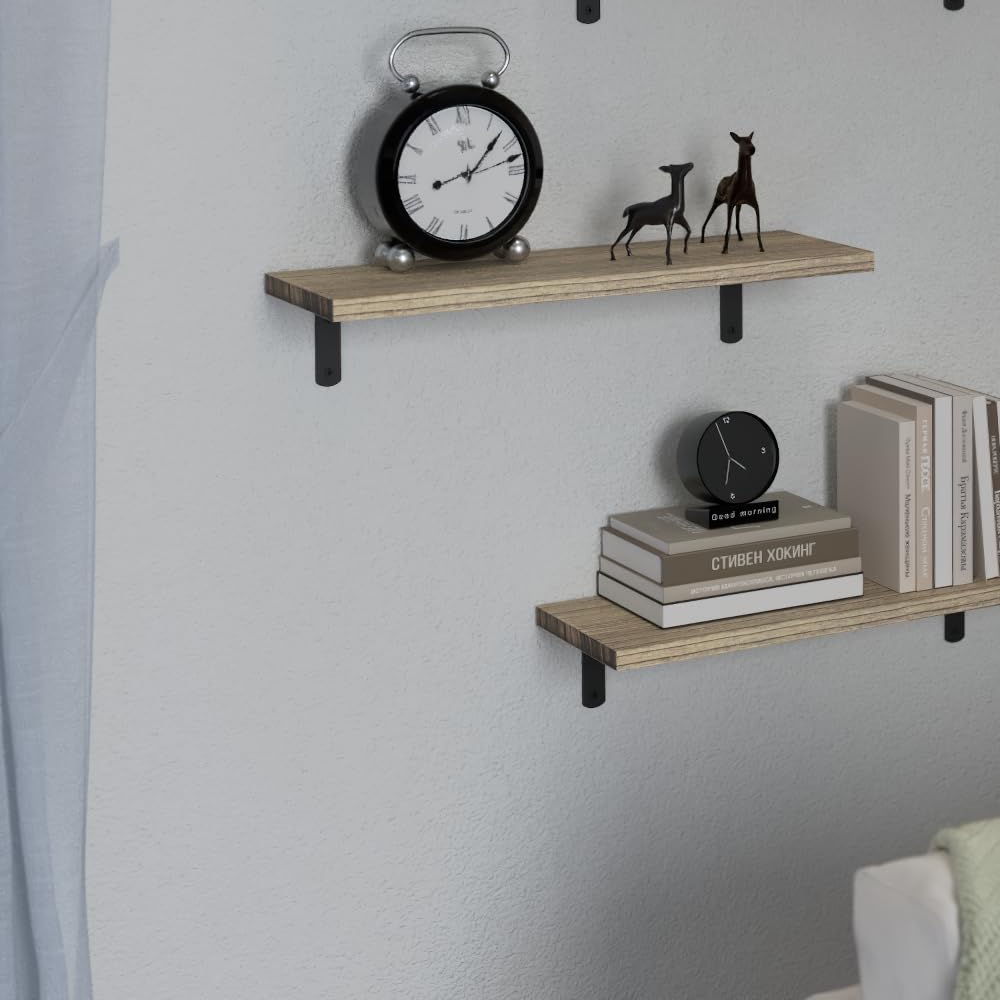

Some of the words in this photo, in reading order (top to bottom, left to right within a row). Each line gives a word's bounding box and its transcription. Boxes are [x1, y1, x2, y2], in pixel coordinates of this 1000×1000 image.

[722, 416, 731, 424] 12
[760, 446, 766, 454] 3
[739, 506, 777, 517] morning
[711, 551, 763, 571] СТИВЕН
[767, 542, 816, 563] ХОКИНГ
